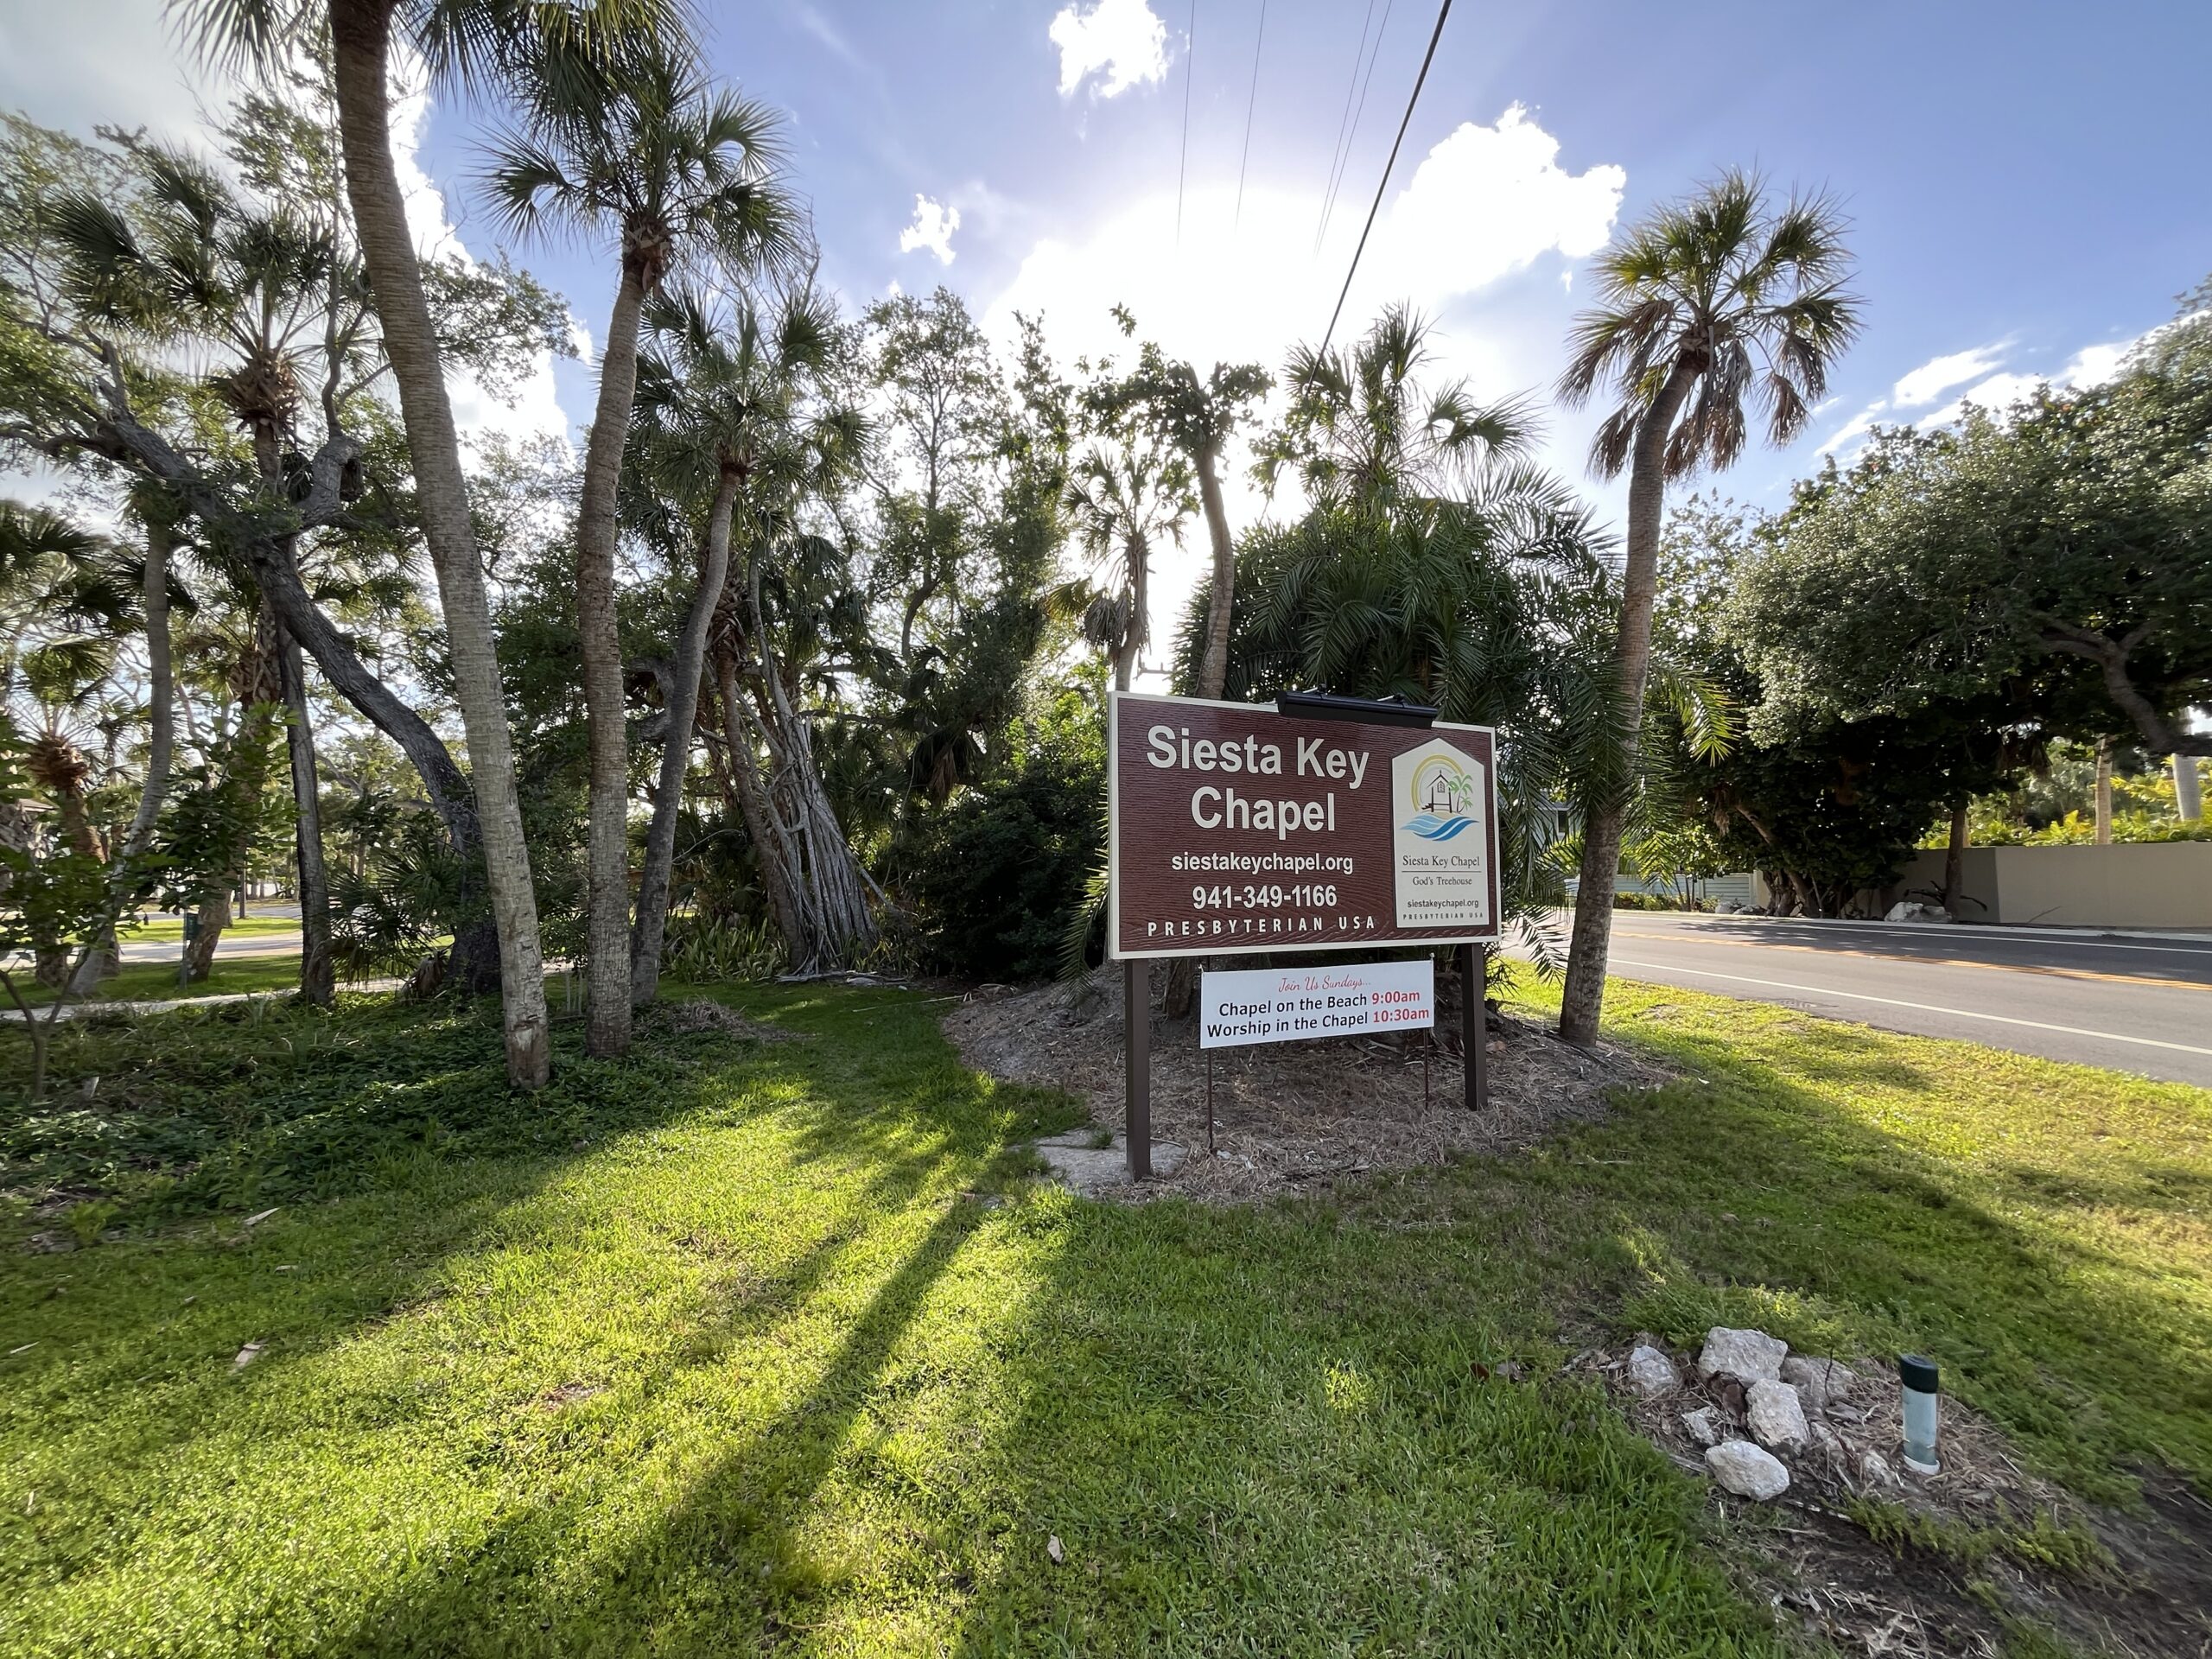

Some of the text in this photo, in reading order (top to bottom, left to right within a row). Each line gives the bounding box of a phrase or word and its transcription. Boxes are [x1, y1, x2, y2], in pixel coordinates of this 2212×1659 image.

[1147, 725, 1369, 790] Siesta Key
[1191, 786, 1335, 840] Chapel
[1172, 852, 1353, 874] siestakeychapel.org
[1402, 855, 1479, 868] Siesta Key Chapel
[1413, 876, 1433, 885] God's
[1192, 885, 1338, 909] 941-349-1166
[1408, 899, 1478, 908] siestakeychapel.org
[1147, 916, 1375, 937] PRESBYTERIAN USA
[1279, 977, 1300, 992] Join
[1305, 976, 1319, 990] Us
[1219, 991, 1420, 1017] Chapel on the Beach 9:00am
[1207, 1008, 1429, 1037] Worship in the Chapel 10:30am
